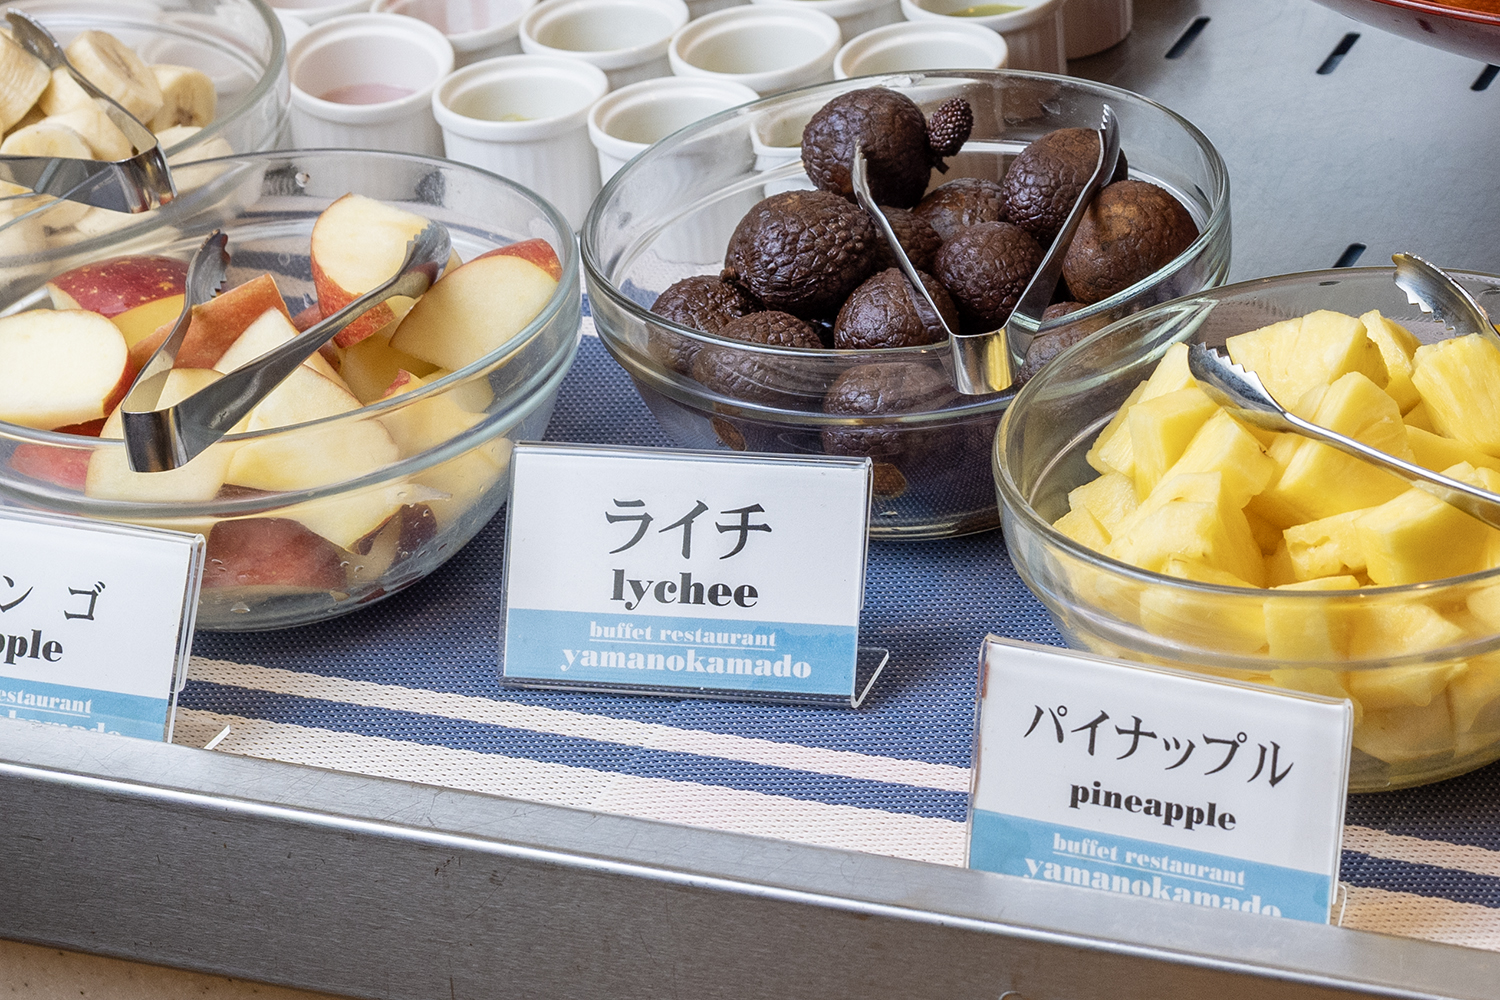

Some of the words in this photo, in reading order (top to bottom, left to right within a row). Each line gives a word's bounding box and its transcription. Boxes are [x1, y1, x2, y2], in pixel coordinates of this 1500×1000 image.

[605, 498, 772, 560] ライチ
[610, 569, 759, 611] lychee
[0, 629, 63, 665] ple
[589, 621, 652, 641] buffet
[659, 625, 776, 647] restaurant
[560, 647, 811, 679] yamanokamado
[1024, 704, 1294, 788] パイナップル
[1068, 780, 1237, 831] pineapple
[1052, 832, 1118, 862] buffet
[1124, 850, 1245, 886] restaurant
[1024, 857, 1282, 918] yamanokamado
